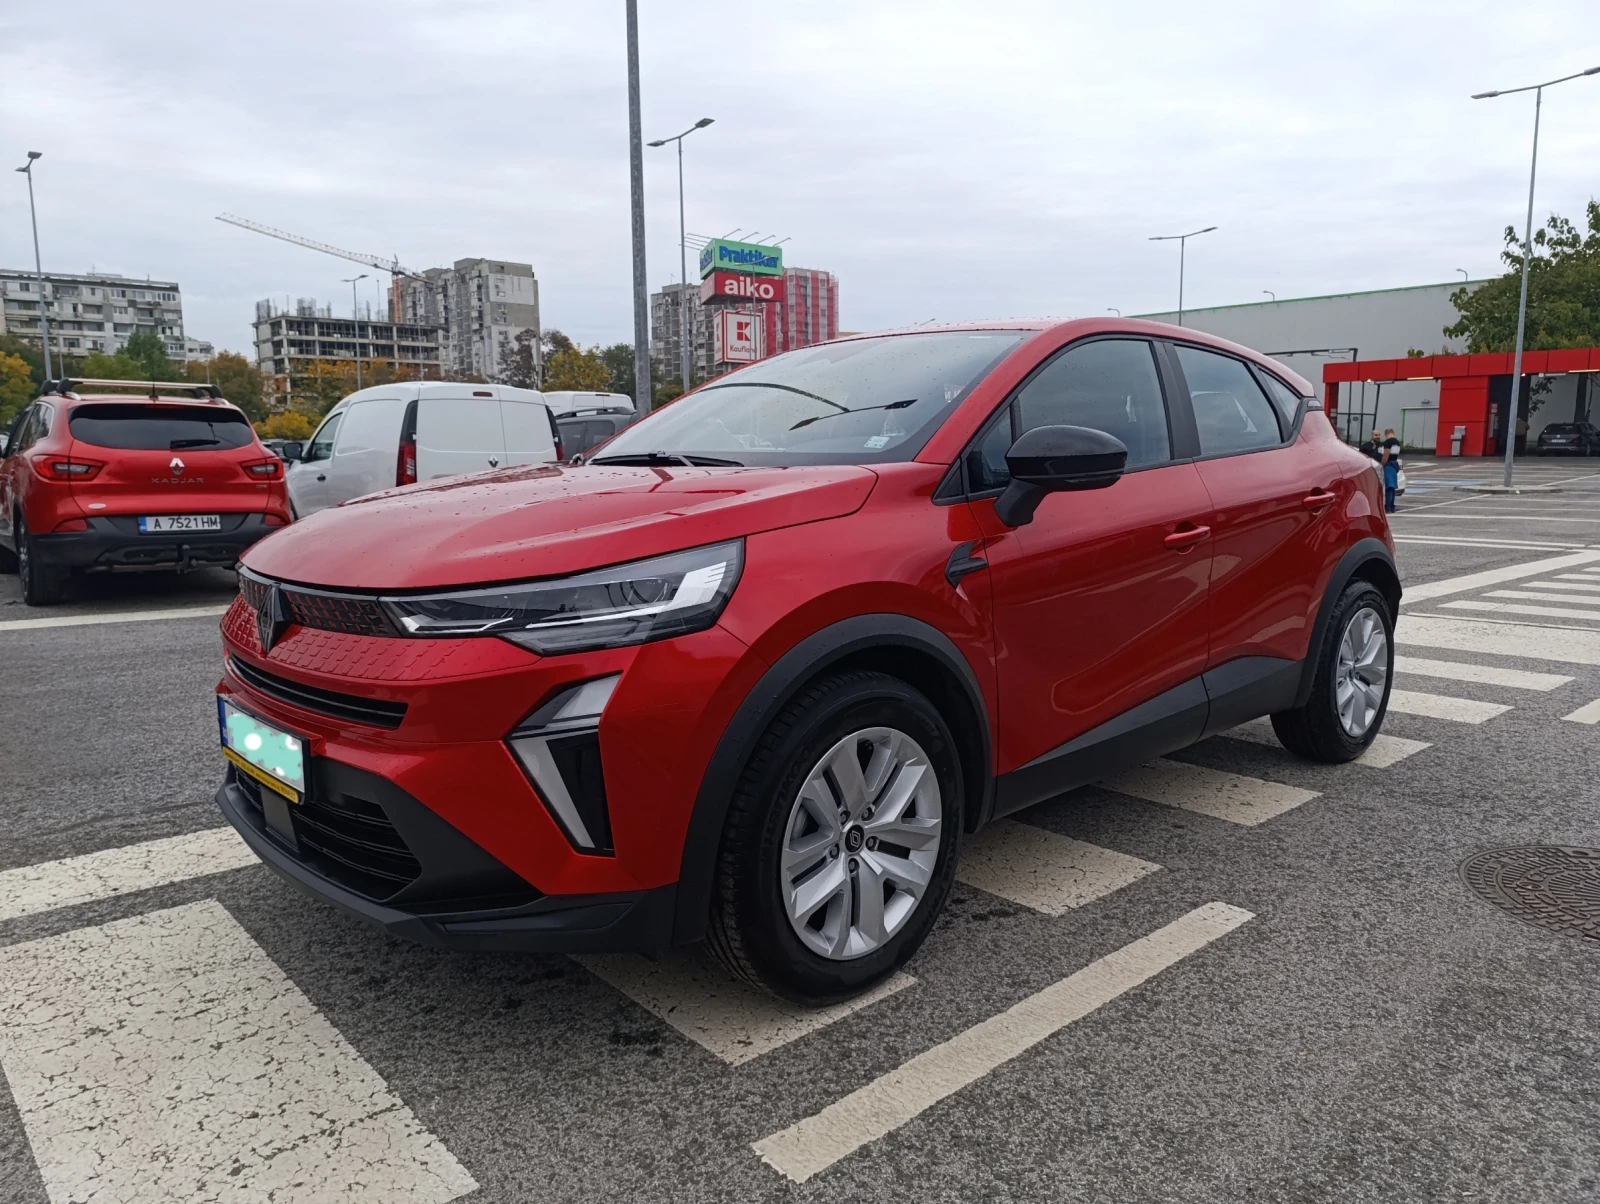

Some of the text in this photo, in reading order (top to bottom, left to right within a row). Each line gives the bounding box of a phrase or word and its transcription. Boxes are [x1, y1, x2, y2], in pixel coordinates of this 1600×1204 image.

[724, 276, 774, 299] aiko
[736, 321, 751, 341] K
[154, 518, 161, 529] A
[168, 517, 199, 530] 7521
[201, 517, 218, 529] HM
